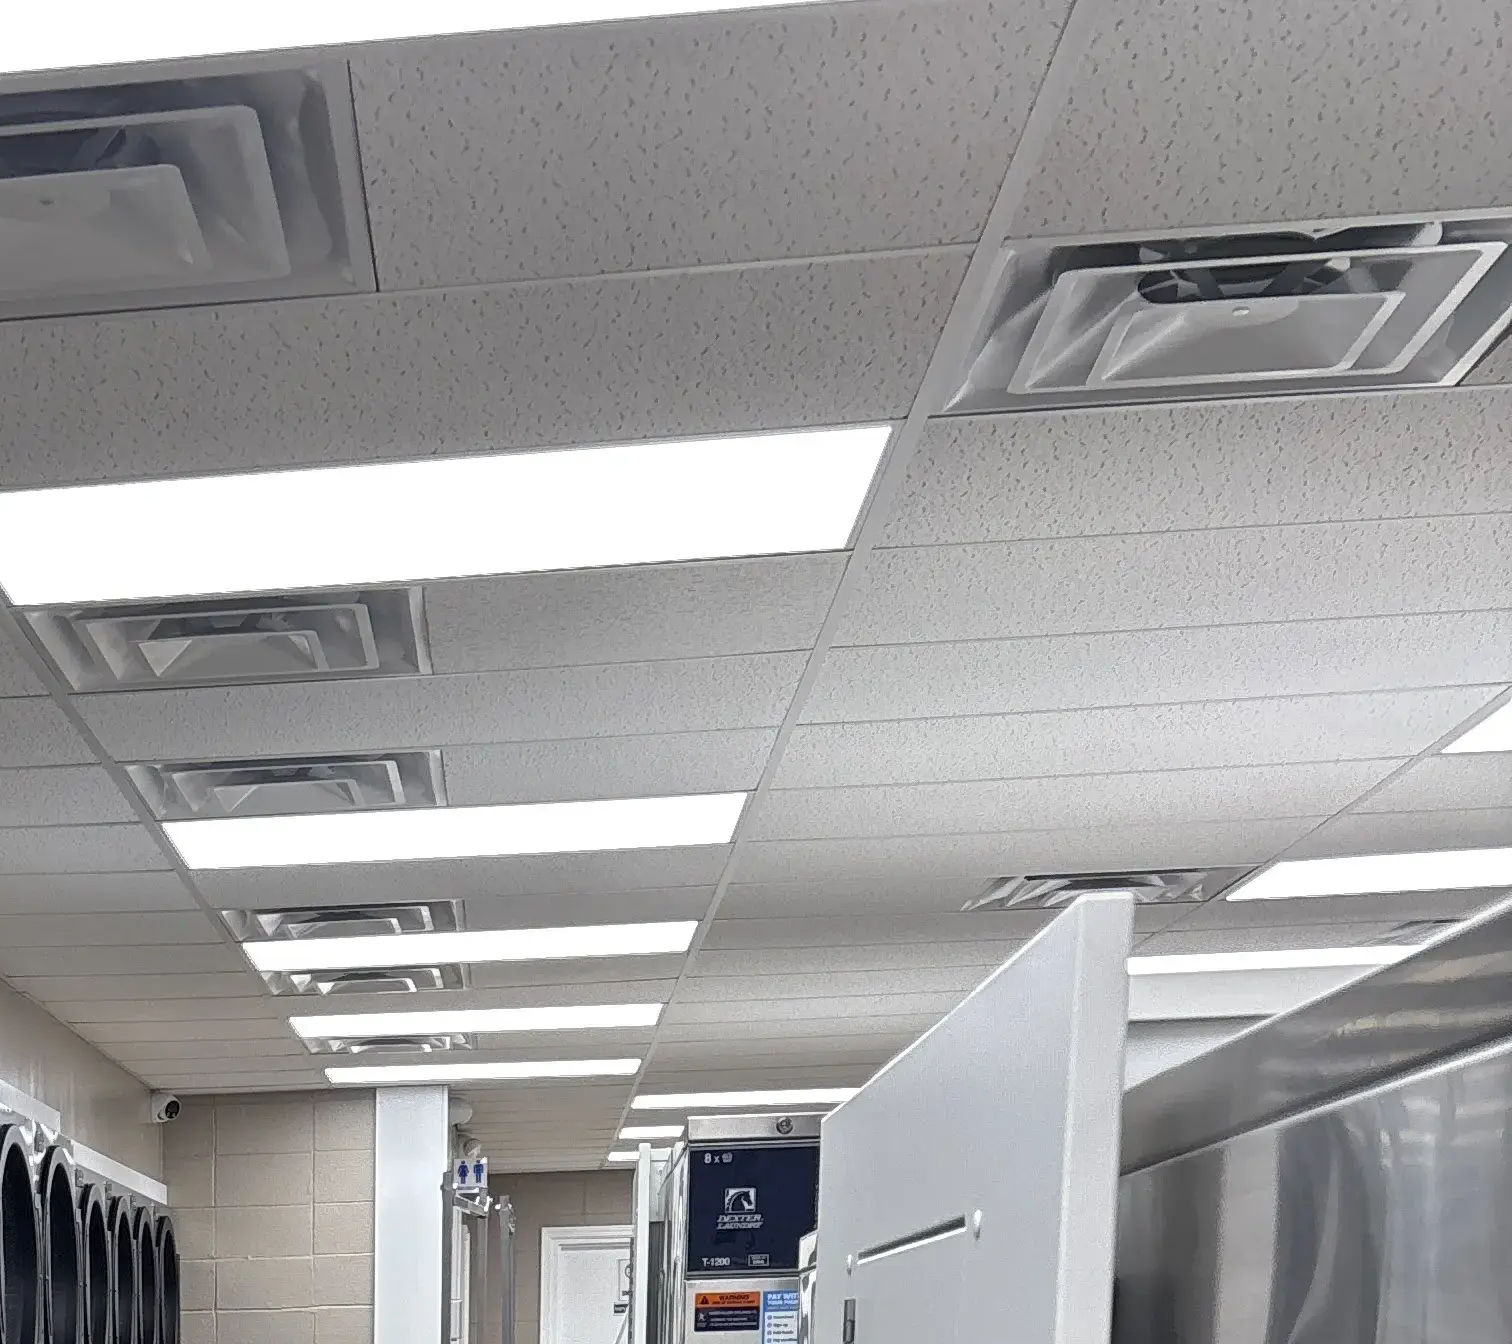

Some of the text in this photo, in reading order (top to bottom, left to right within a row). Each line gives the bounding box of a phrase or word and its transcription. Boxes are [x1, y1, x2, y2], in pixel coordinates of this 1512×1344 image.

[704, 1153, 712, 1163] 8
[717, 1214, 762, 1222] DEXTER
[702, 1257, 731, 1267] T-1200
[783, 1292, 800, 1300] WIT
